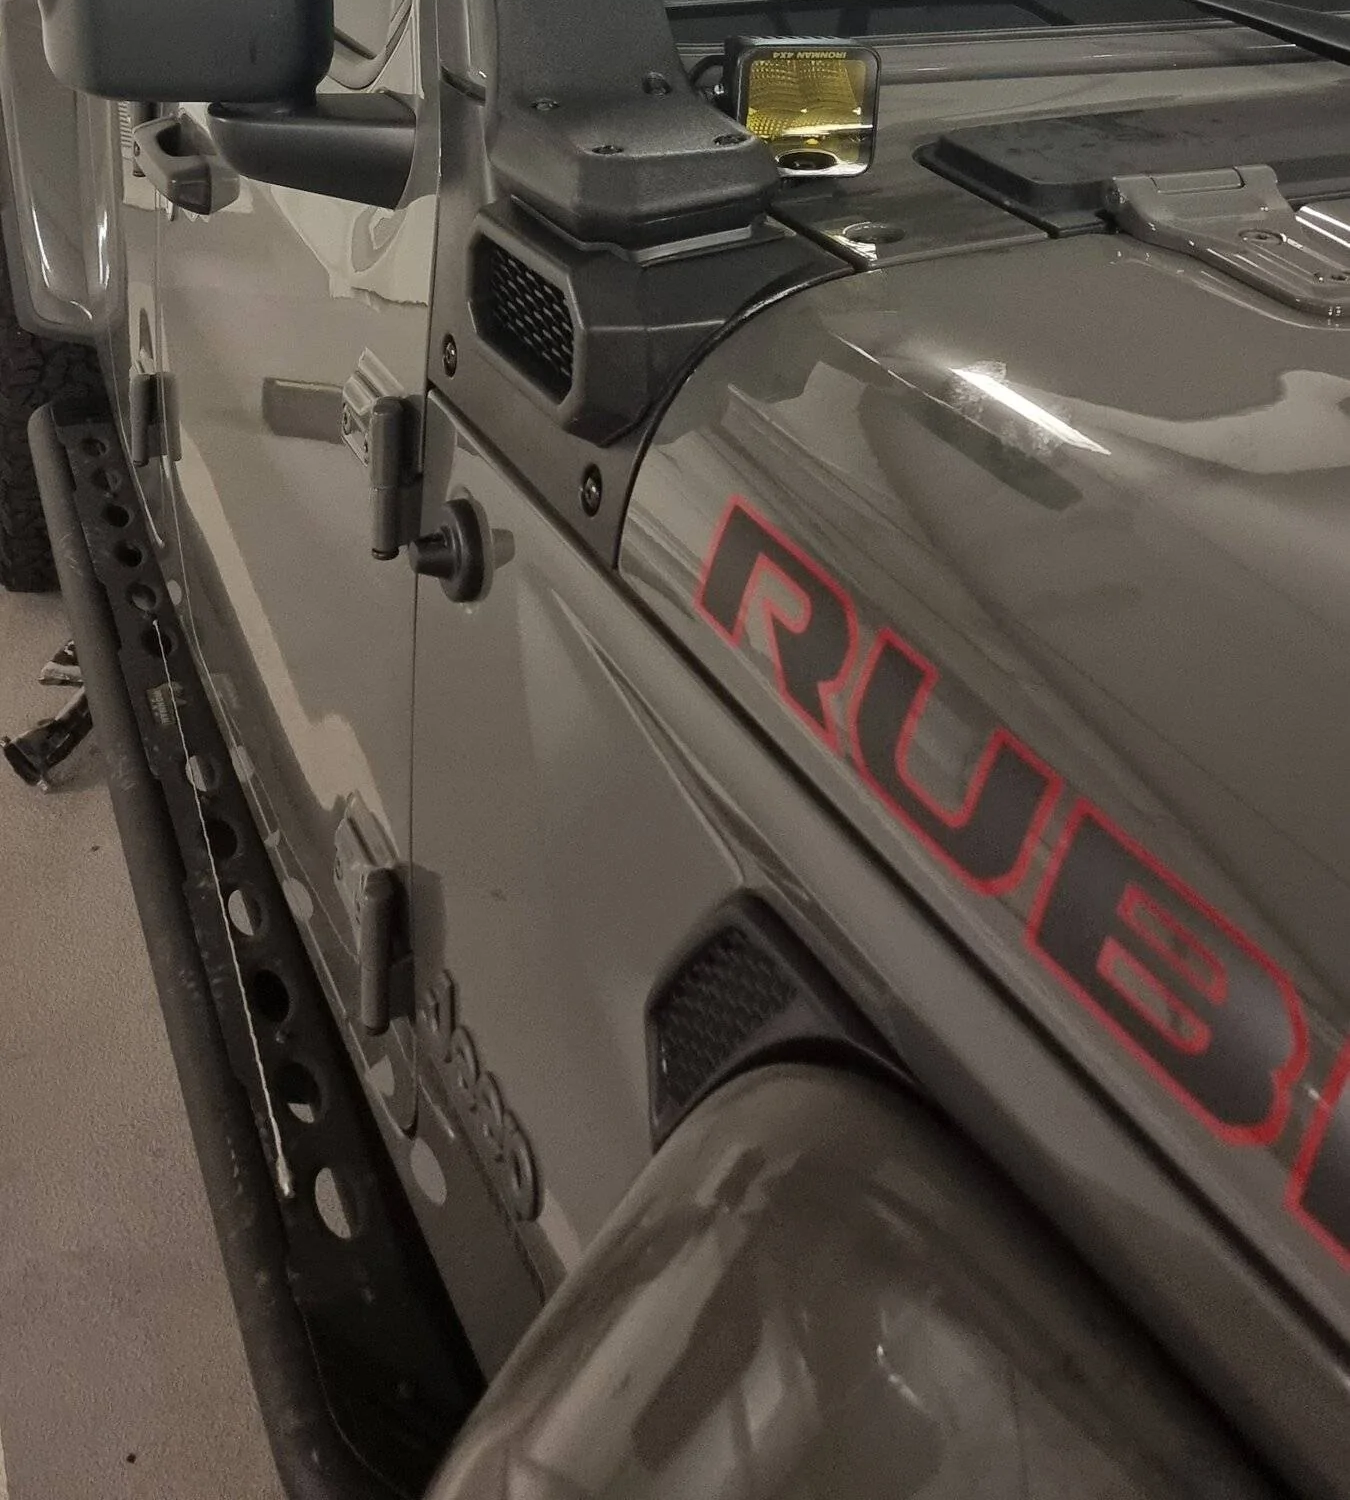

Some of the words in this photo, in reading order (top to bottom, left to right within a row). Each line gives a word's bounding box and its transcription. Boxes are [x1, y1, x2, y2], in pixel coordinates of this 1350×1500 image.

[772, 51, 795, 59] 4X4
[796, 51, 847, 59] IRONMAN
[416, 968, 541, 1222] Jeep
